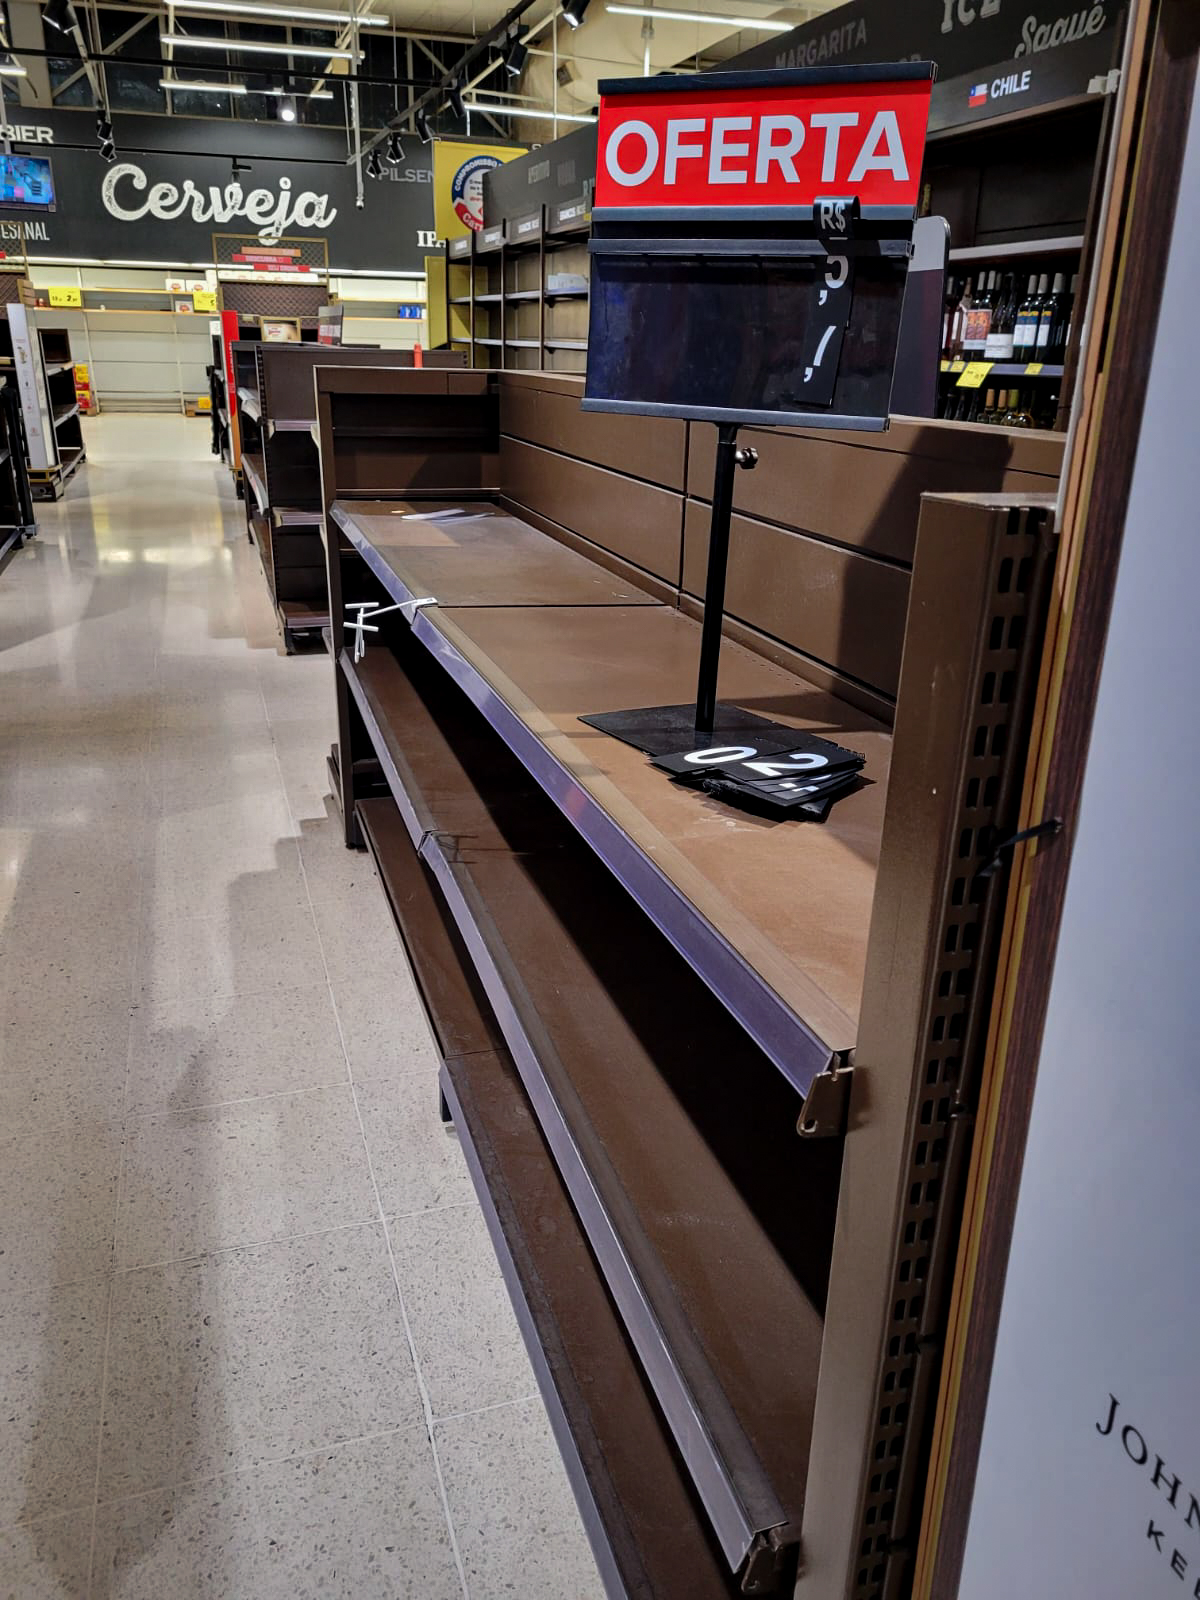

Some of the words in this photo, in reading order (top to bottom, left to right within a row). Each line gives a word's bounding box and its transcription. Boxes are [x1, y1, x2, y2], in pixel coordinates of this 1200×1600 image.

[775, 18, 868, 69] MARGARITA
[990, 70, 1031, 98] CHILE
[605, 110, 910, 187] OFERTA
[102, 163, 337, 246] Cerveja
[820, 201, 846, 232] R$
